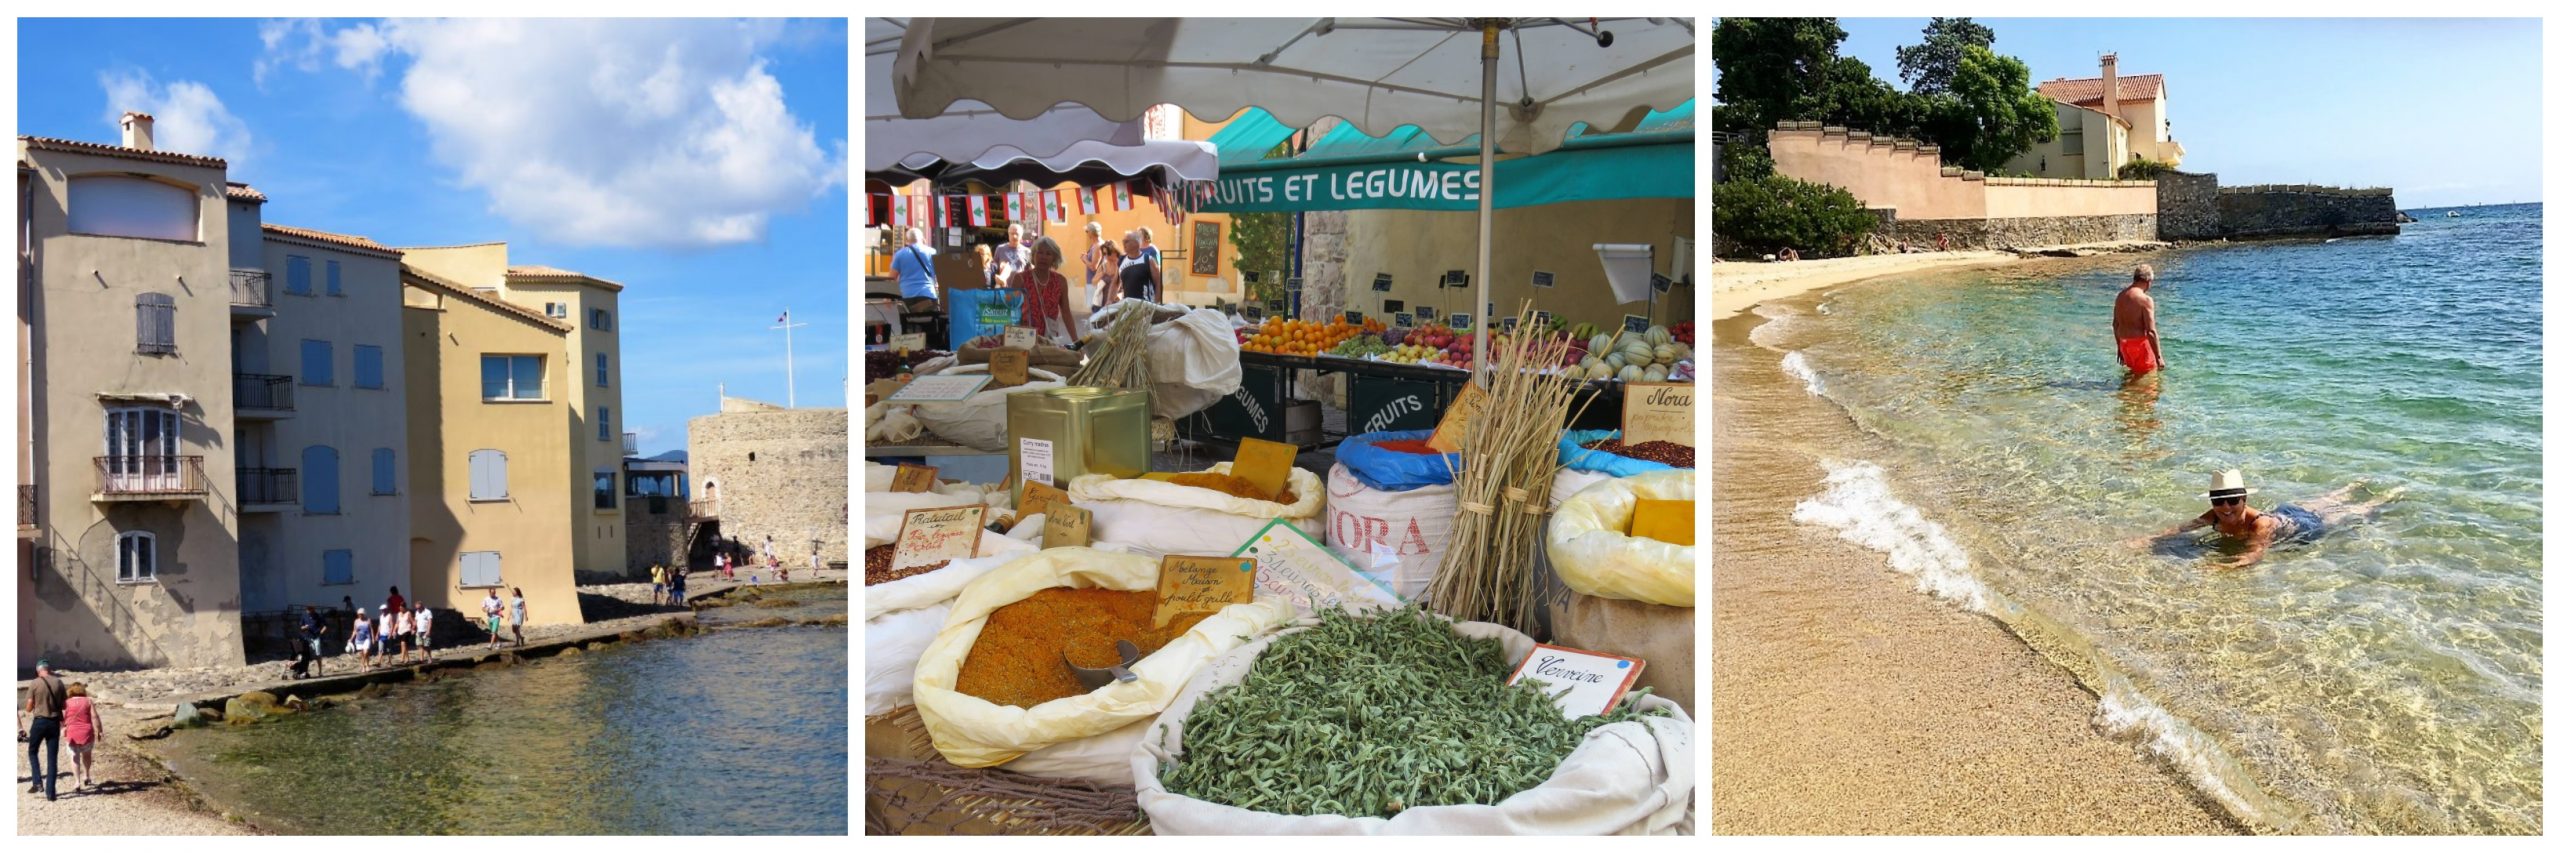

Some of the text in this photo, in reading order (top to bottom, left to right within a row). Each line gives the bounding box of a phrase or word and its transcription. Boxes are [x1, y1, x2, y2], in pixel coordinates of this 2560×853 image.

[1284, 174, 1319, 201] ET
[1330, 168, 1481, 200] LEGUMES
[1646, 387, 1692, 407] Nora
[1364, 394, 1422, 434] FRUITS
[1182, 574, 1224, 586] Maison
[1536, 655, 1604, 684] Verveine
